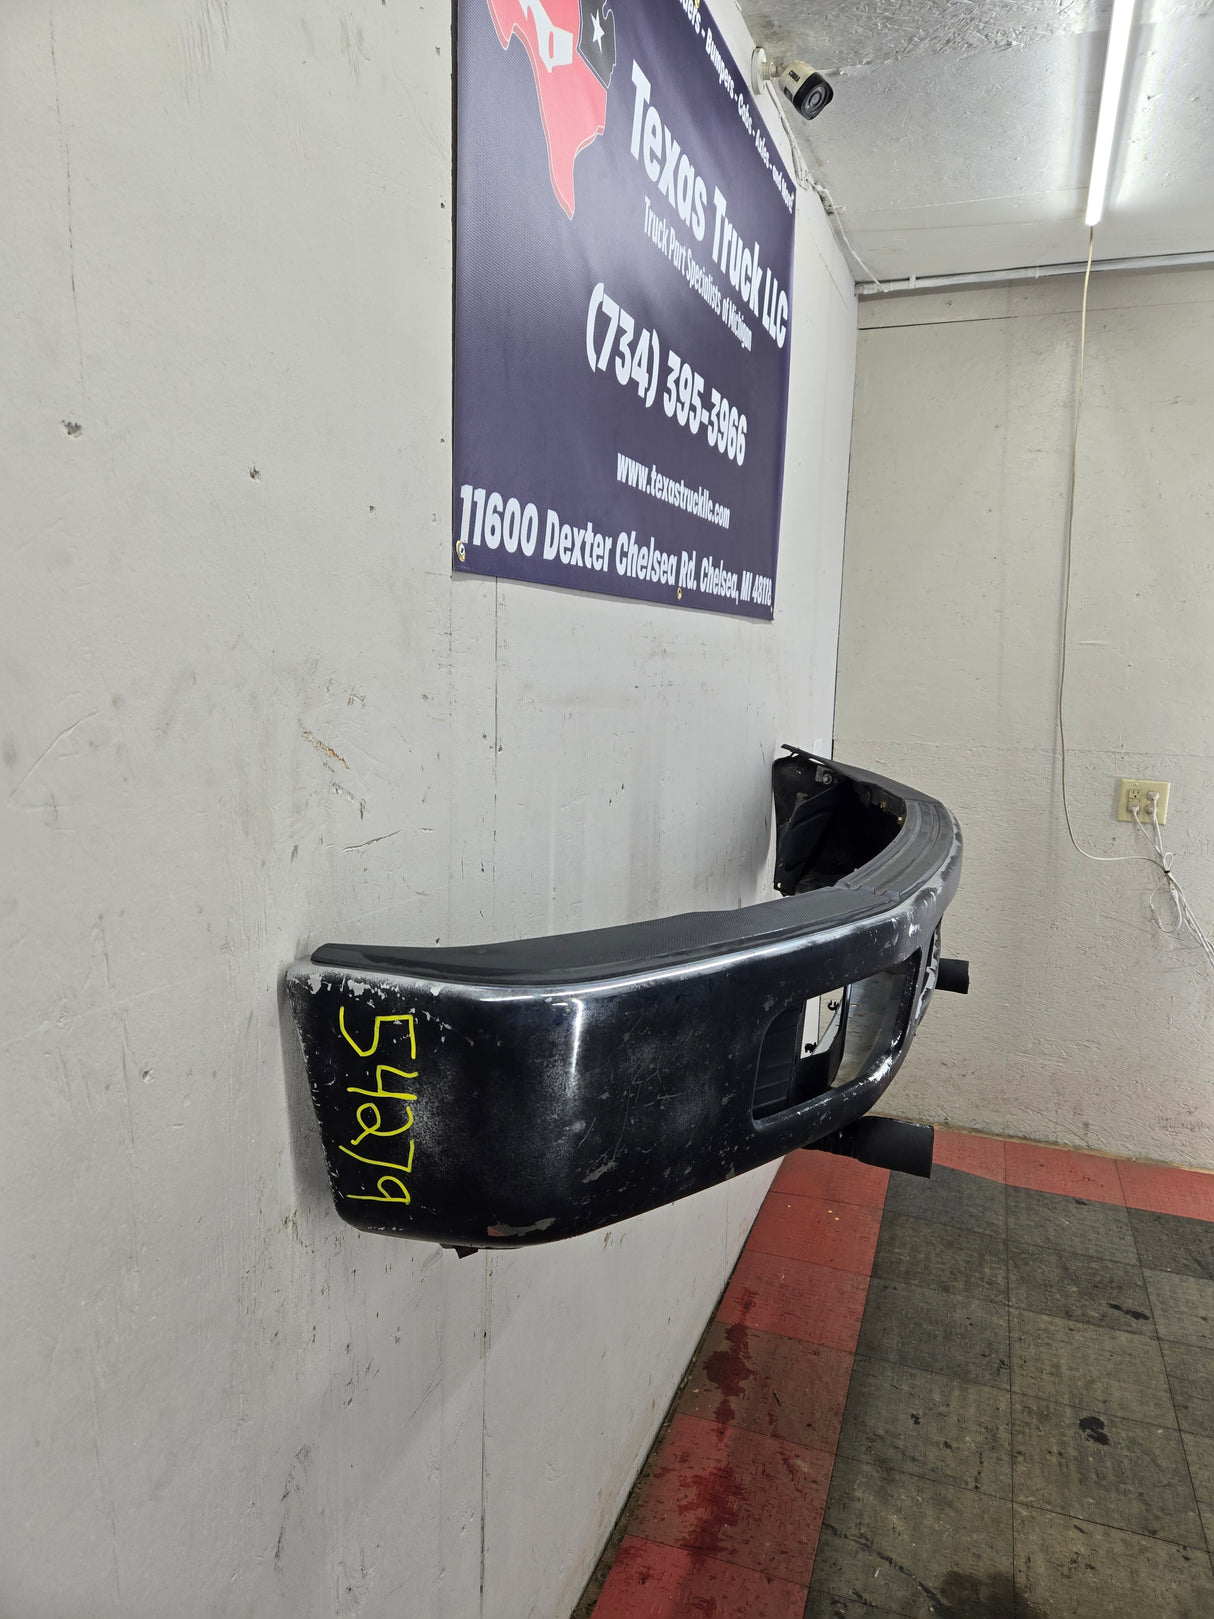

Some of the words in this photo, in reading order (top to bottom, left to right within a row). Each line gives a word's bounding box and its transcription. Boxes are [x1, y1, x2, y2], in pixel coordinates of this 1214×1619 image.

[705, 27, 735, 100] Bumpers
[630, 59, 708, 242] Texas
[712, 186, 764, 318] Truck
[762, 267, 789, 349] LLC
[644, 195, 670, 256] Truck
[668, 226, 687, 276] Part
[686, 248, 721, 316] Specialists
[721, 297, 730, 323] of
[727, 301, 752, 352] Michigan
[586, 282, 661, 408] (734)
[663, 349, 748, 467] 395-3966
[459, 484, 539, 557] 11600
[543, 509, 613, 572] Dexter
[615, 530, 678, 586] Chelsea
[678, 550, 698, 591] Rd.
[700, 556, 739, 605] Chelsea,
[740, 570, 752, 602] MI
[752, 575, 772, 606] 48118
[616, 452, 731, 529] www.texastruckllc.com
[337, 1005, 419, 1206] 54279
